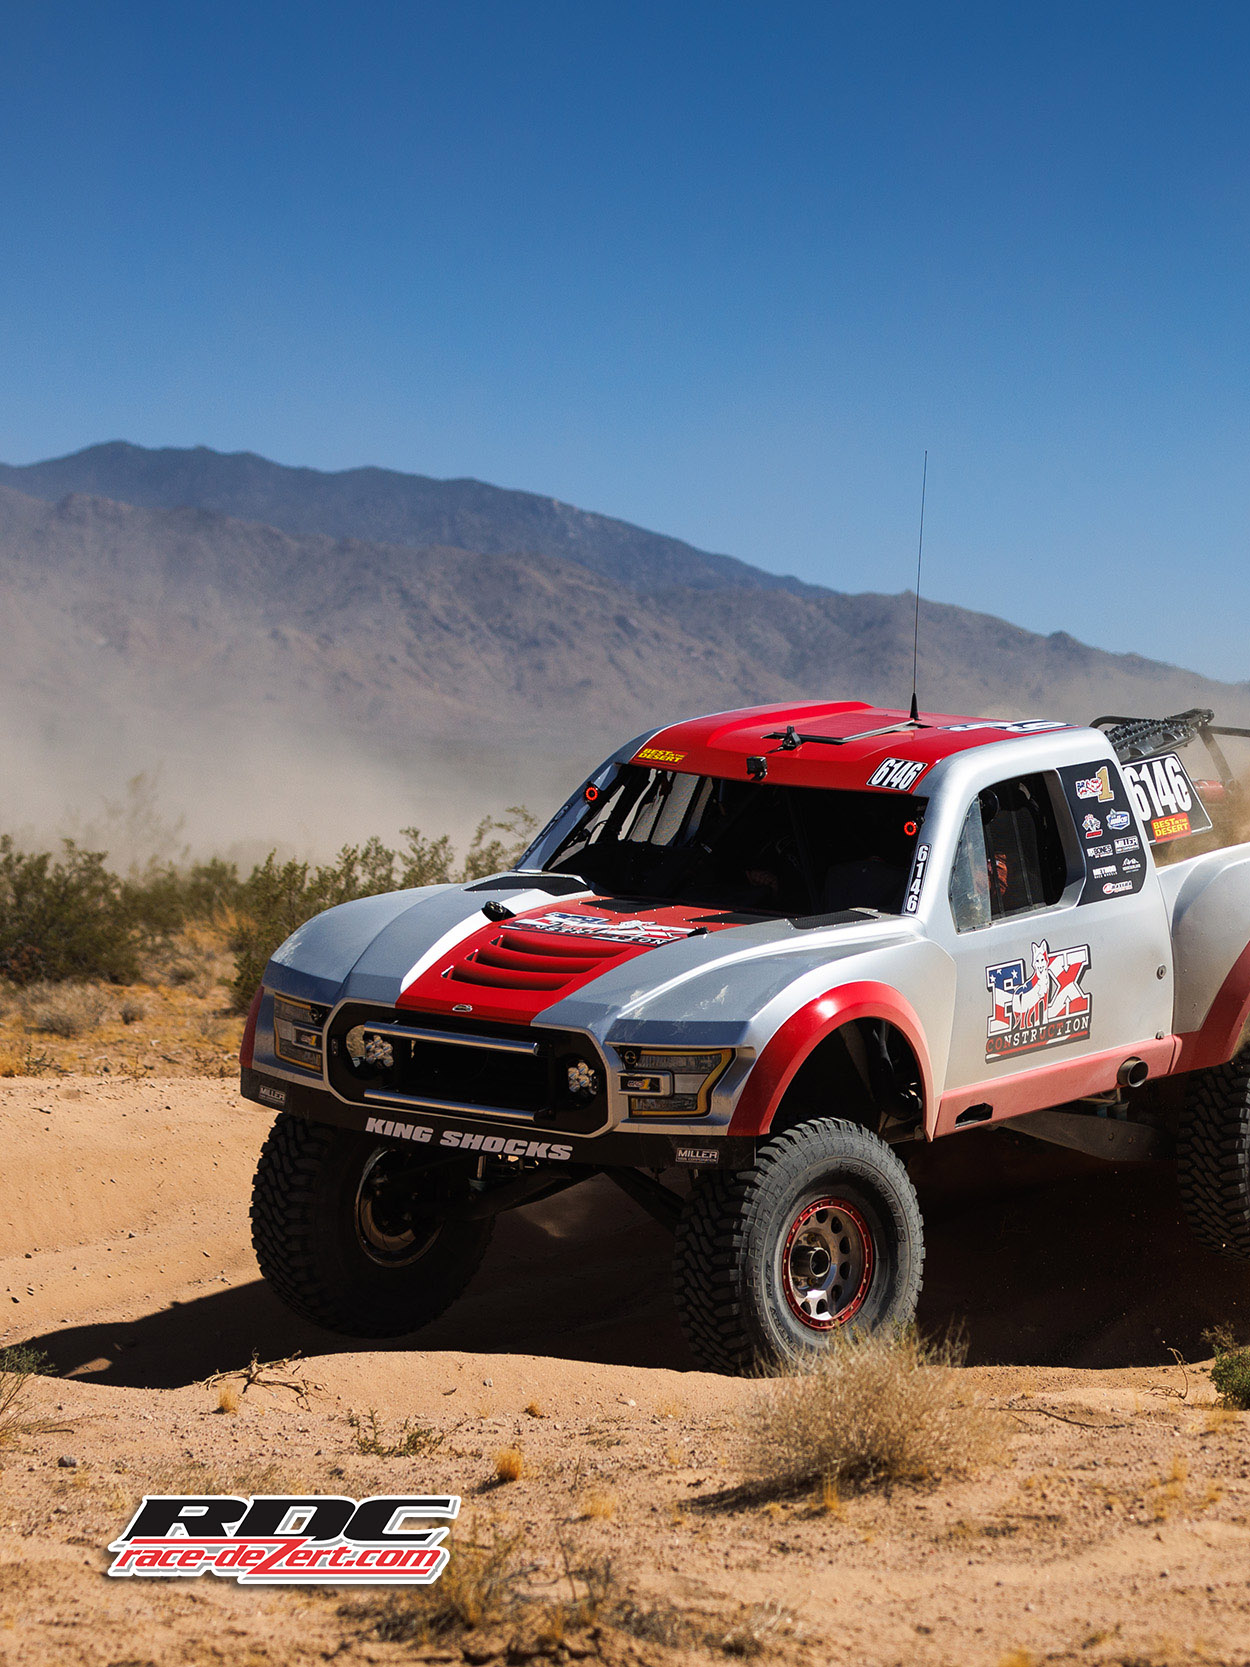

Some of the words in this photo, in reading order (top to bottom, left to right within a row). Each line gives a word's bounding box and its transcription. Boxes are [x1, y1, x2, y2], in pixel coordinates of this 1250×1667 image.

[638, 753, 682, 763] DESERT
[642, 748, 673, 757] BEST
[871, 759, 924, 790] 6146
[1122, 757, 1192, 822] 6146
[1152, 818, 1175, 830] BEST
[1154, 823, 1189, 837] DESERT
[906, 845, 929, 912] 6146
[986, 1015, 1090, 1053] CONSTRUCTION
[365, 1117, 434, 1143] KING
[439, 1130, 574, 1161] SHOCKS
[678, 1149, 718, 1159] MILLER
